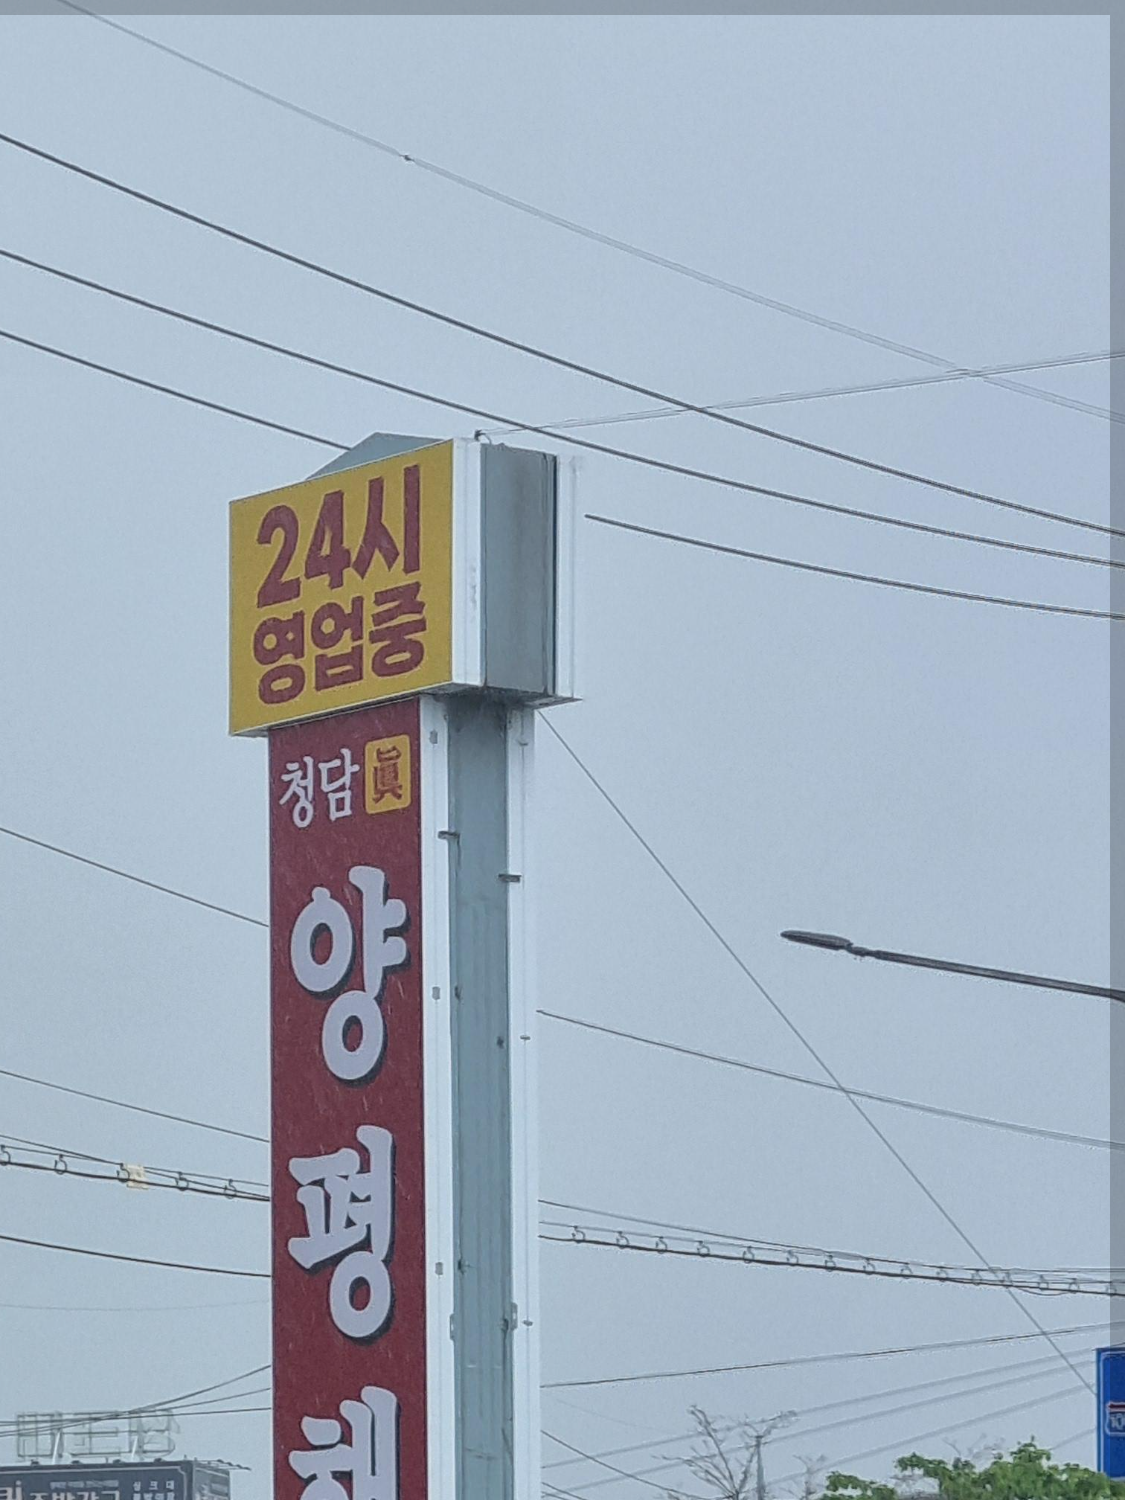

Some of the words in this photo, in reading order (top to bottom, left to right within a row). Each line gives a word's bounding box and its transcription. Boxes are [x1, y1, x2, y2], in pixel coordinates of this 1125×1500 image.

[256, 463, 421, 608] 24시
[252, 581, 427, 705] 영업중
[278, 748, 360, 828] 청담
